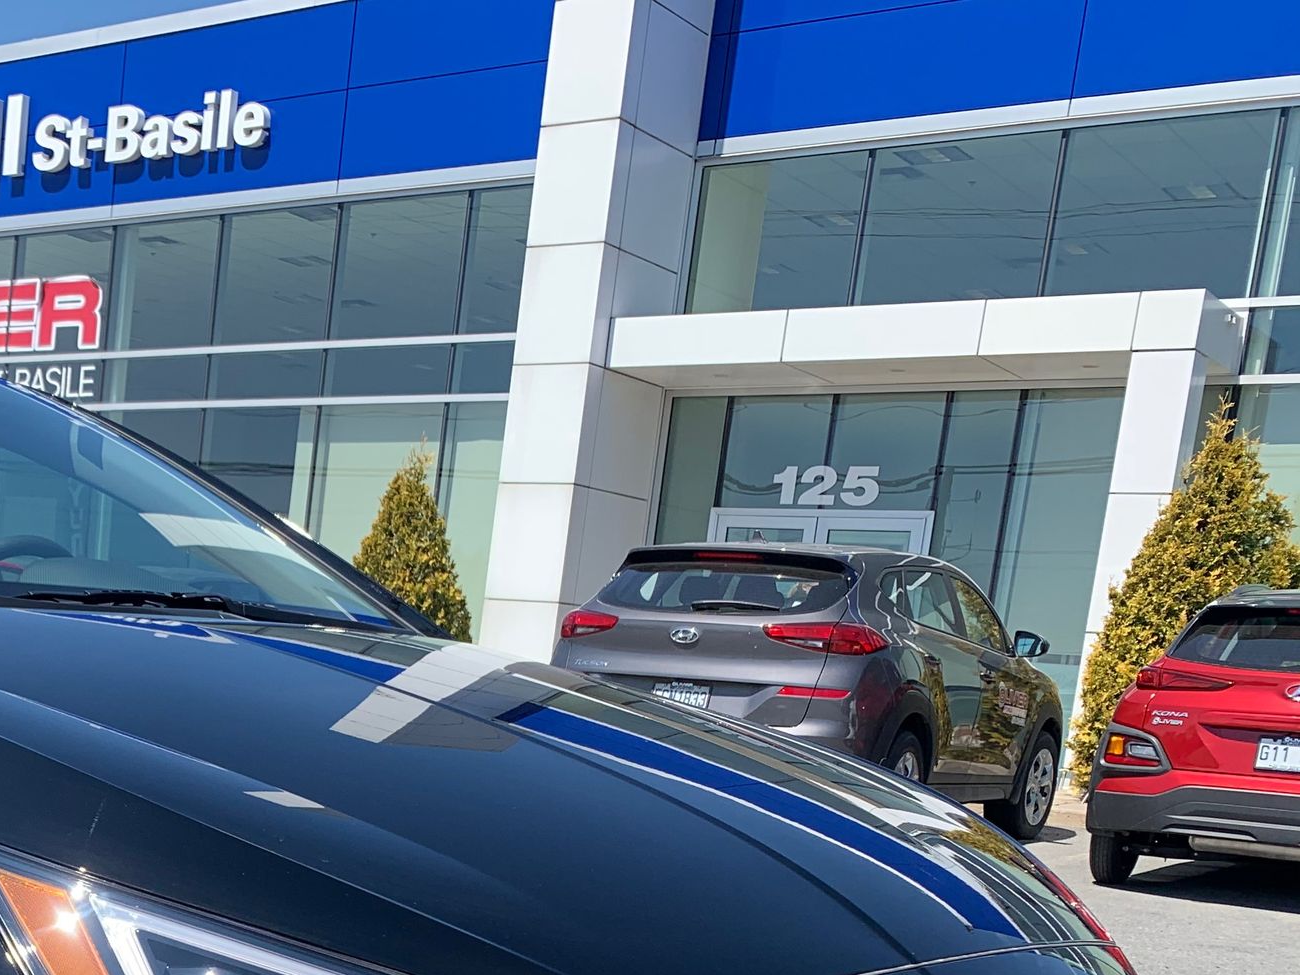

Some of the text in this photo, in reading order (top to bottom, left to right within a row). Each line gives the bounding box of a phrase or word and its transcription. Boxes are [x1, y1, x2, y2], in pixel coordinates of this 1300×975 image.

[32, 88, 271, 174] St-Basile
[15, 365, 96, 398] BASILE
[773, 465, 881, 506] 125
[1151, 710, 1189, 718] KONA
